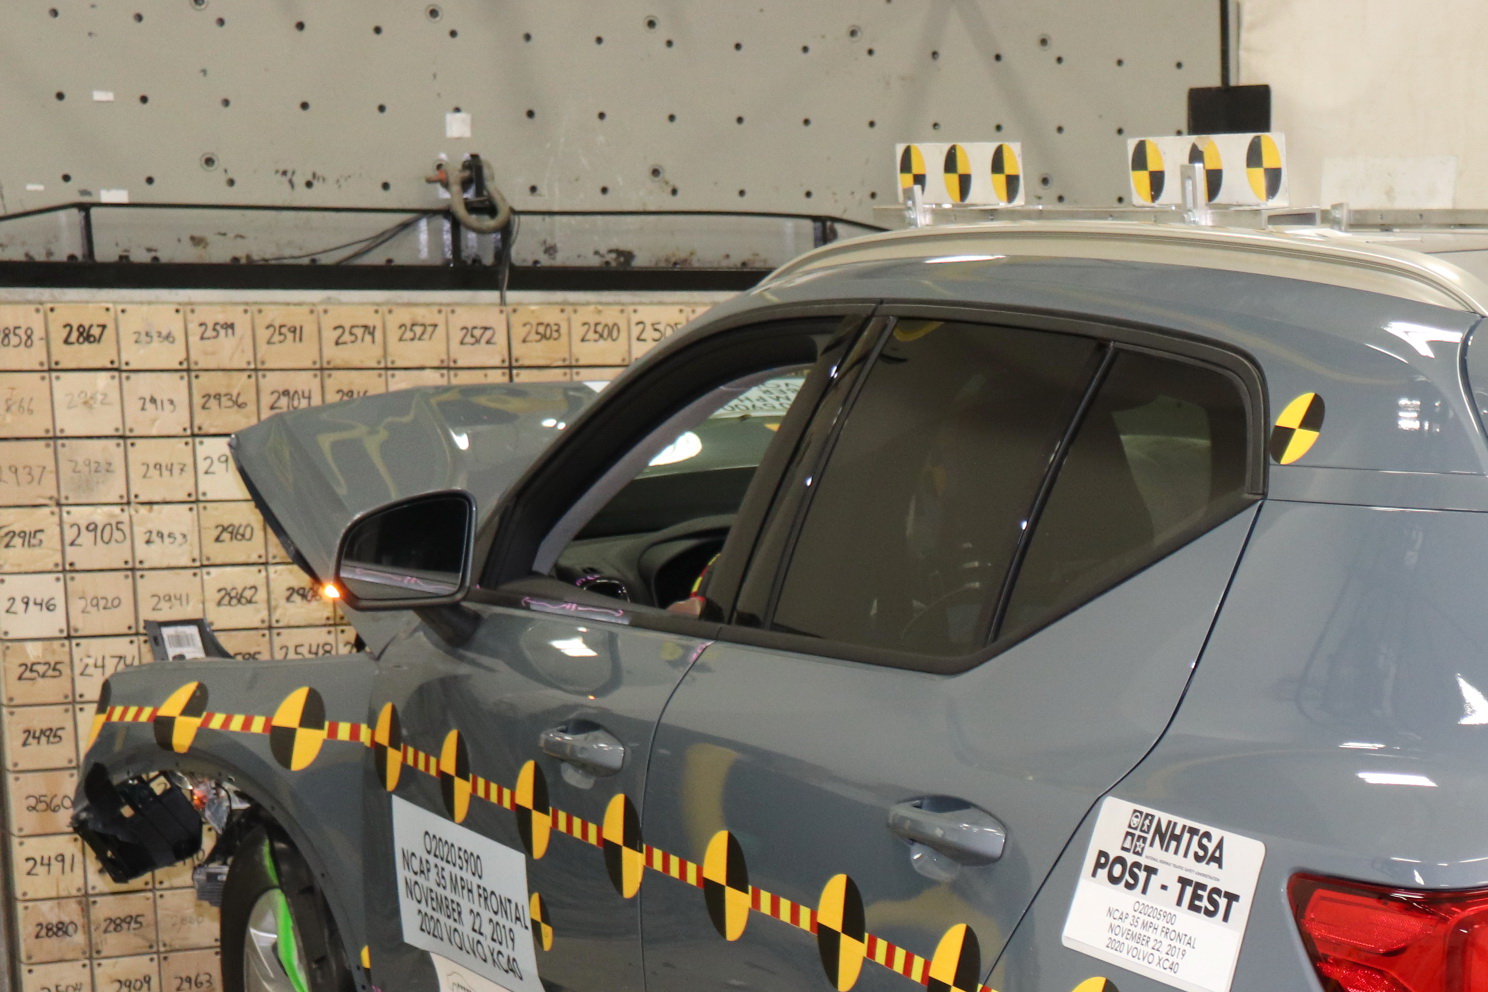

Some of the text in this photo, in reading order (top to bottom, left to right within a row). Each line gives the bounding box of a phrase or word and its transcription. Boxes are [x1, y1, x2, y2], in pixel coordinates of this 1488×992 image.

[0, 326, 34, 348] 858
[62, 323, 108, 345] 2867
[265, 324, 303, 345] 2591
[333, 325, 376, 346] 2574
[398, 323, 438, 342] 2527
[460, 326, 497, 346] 2572
[521, 322, 562, 344] 2503
[580, 322, 621, 343] 2500
[201, 392, 248, 412] 2936
[270, 389, 312, 410] 2904
[141, 462, 187, 479] 2947
[203, 454, 229, 474] 29
[4, 529, 45, 549] 2915
[68, 521, 127, 547] 2905
[144, 530, 188, 547] 2953
[214, 523, 254, 543] 2960
[5, 596, 57, 615] 2946
[78, 596, 122, 614] 2920
[151, 594, 190, 612] 2941
[216, 586, 258, 607] 2862
[18, 660, 65, 682] 2525
[22, 727, 66, 748] 2495
[25, 793, 74, 813] 2560
[1148, 816, 1225, 870] NHTSA
[25, 853, 75, 876] 2491
[401, 847, 529, 931] NCAP 35 MPH FRONTAL
[1091, 849, 1159, 896] POST
[1175, 875, 1241, 924] TEST
[103, 914, 145, 934] 2895
[404, 876, 464, 927] NOVEMBER
[488, 917, 516, 952] 2019
[35, 920, 78, 939] 2880
[1106, 906, 1197, 950] NCAP 35 MPH FRONTAL
[418, 909, 524, 982] 2020 VOLVO XC40
[1108, 922, 1151, 948] NOVEMBER
[1165, 943, 1187, 960] 2019
[1106, 937, 1180, 974] 2020 VOLVO XC40
[173, 972, 213, 992] 2963
